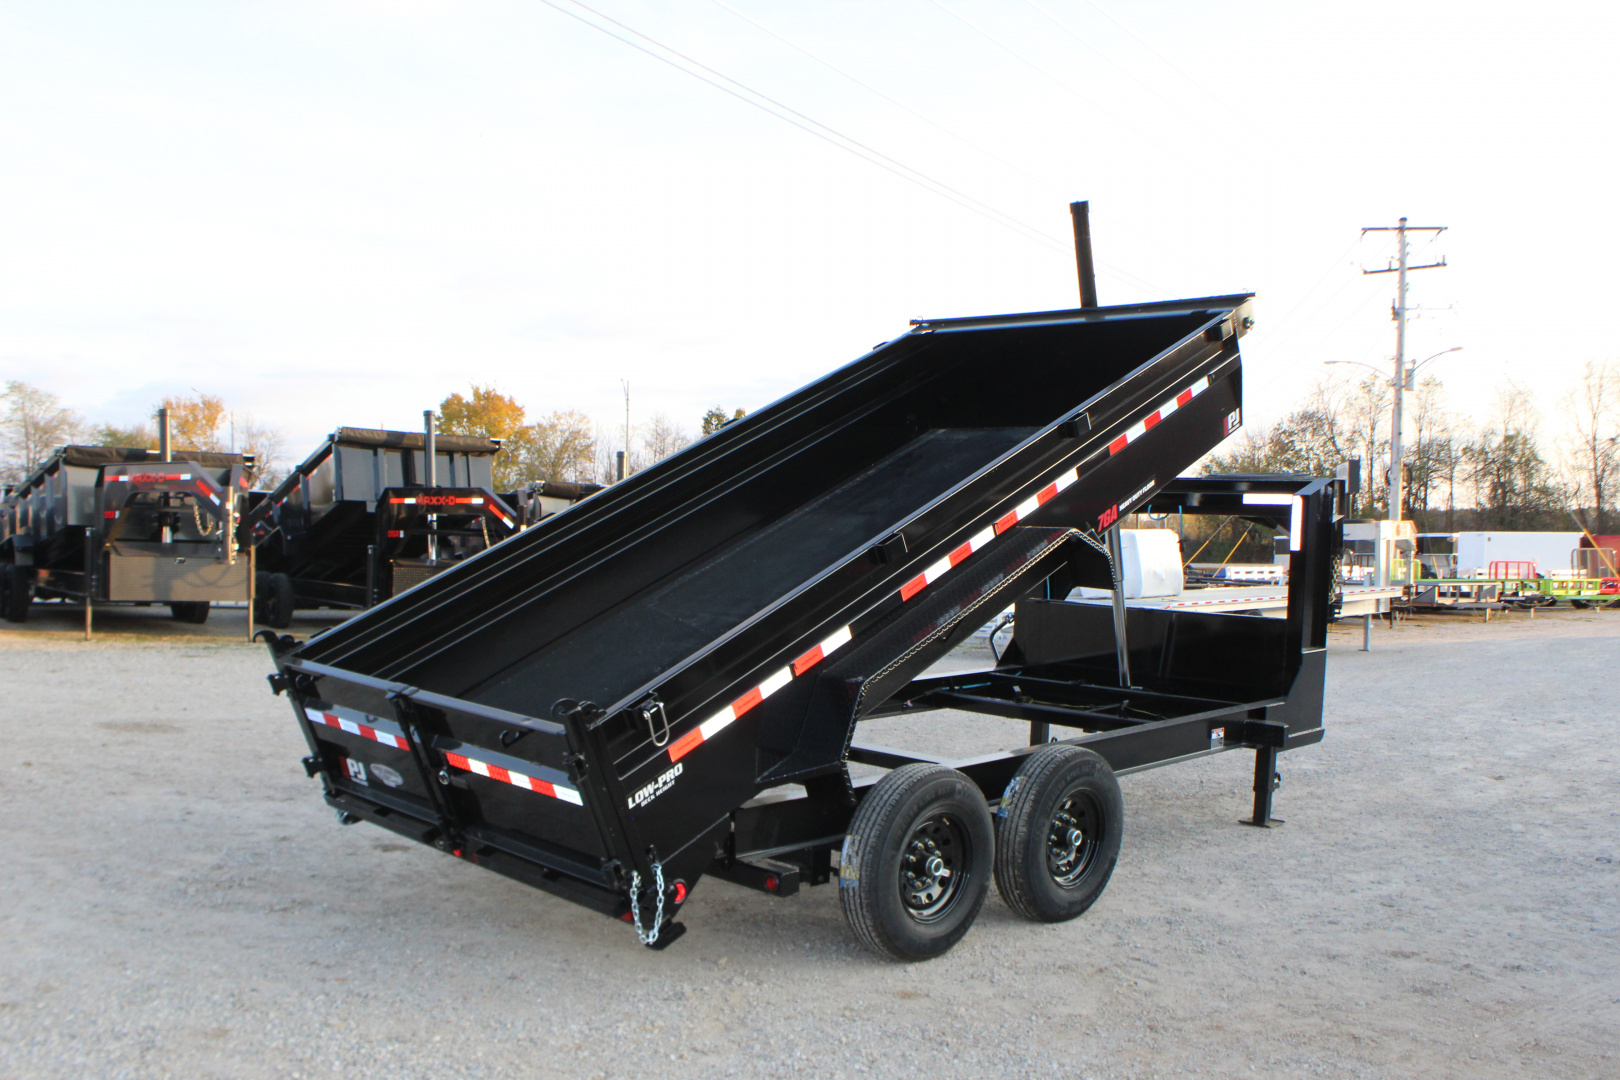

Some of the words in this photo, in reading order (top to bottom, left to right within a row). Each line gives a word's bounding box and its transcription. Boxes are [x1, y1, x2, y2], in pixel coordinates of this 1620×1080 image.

[1227, 407, 1241, 430] PJ
[415, 495, 456, 505] MAXX-D
[346, 758, 367, 781] PJ
[627, 762, 684, 810] LOW-PRO
[640, 794, 656, 808] DECK
[655, 779, 676, 797] HEIGHT
